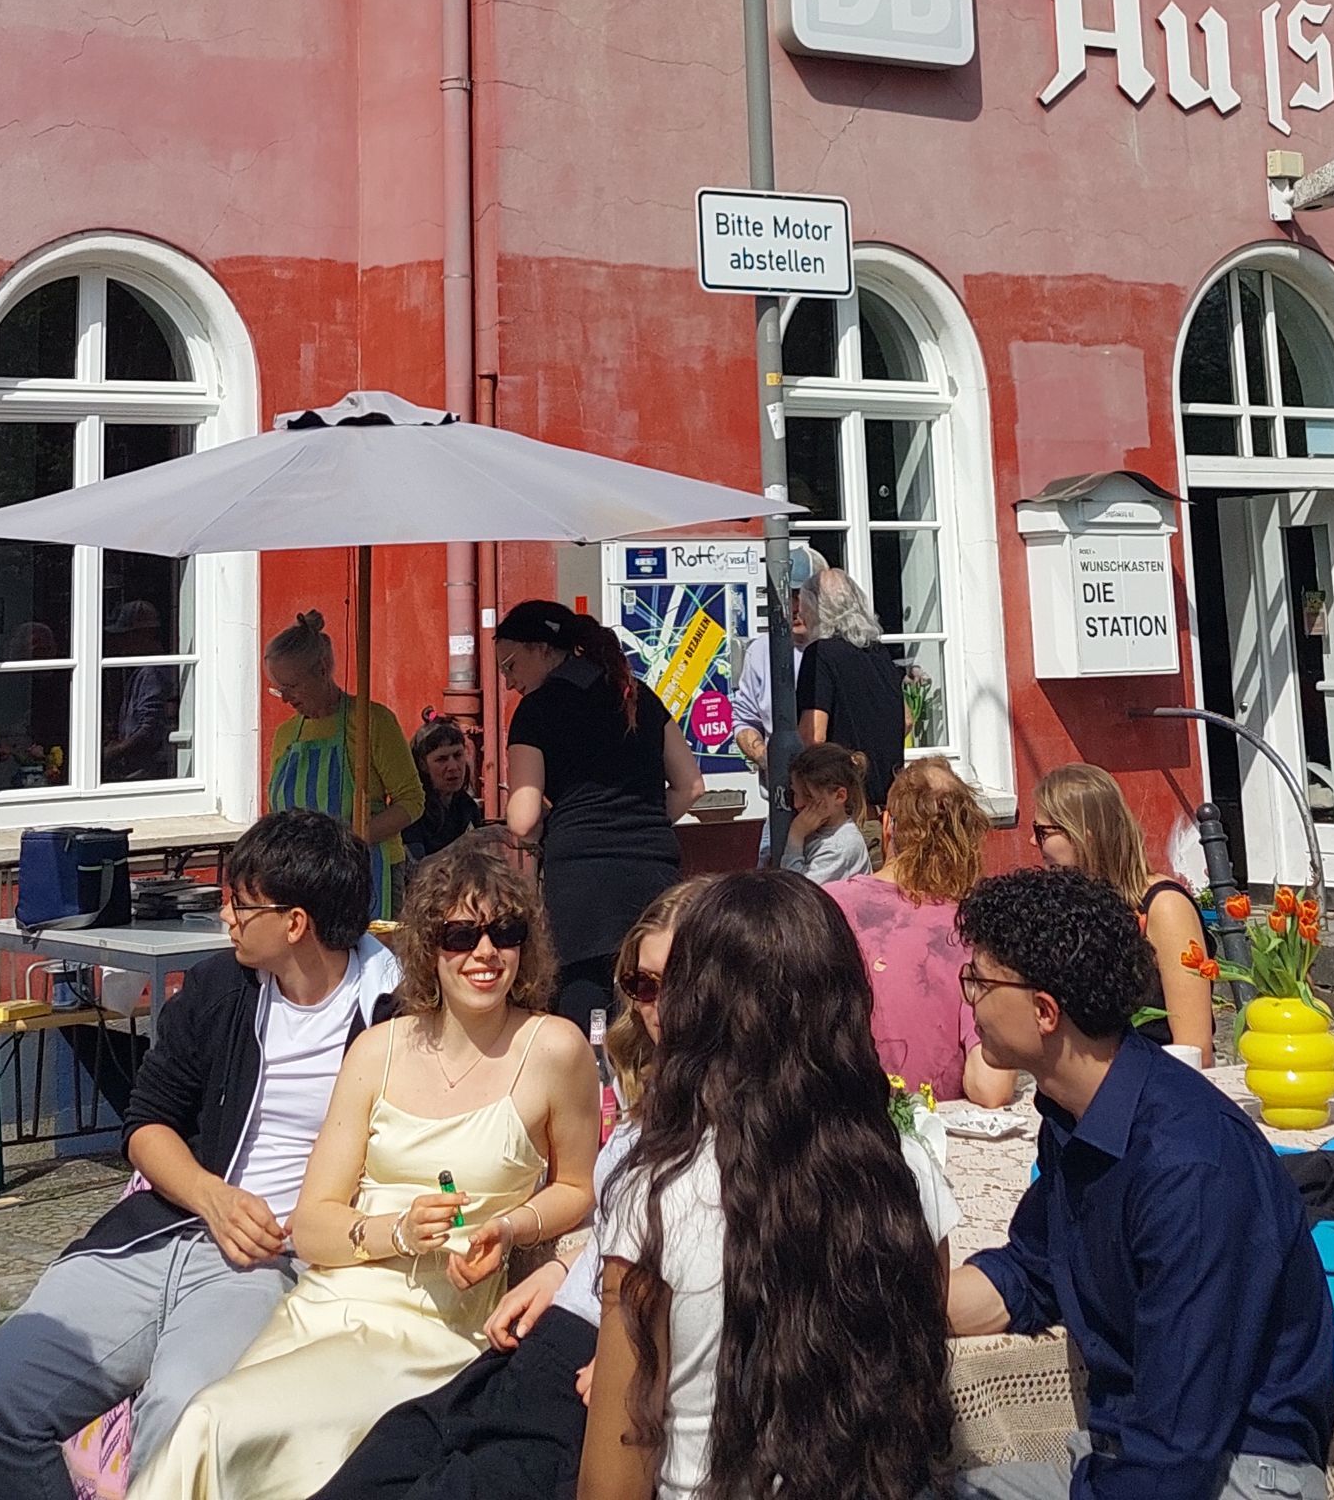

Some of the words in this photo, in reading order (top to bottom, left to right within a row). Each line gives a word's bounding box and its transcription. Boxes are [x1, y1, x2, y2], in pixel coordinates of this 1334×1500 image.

[715, 212, 764, 238] Bitte
[773, 215, 833, 242] Motor
[729, 247, 825, 274] abstellen
[729, 556, 745, 565] VISA
[1079, 560, 1165, 573] WUNSCHKASTEN
[1082, 581, 1116, 603] DIE
[684, 615, 712, 659] BEZAHLEN
[1085, 614, 1168, 638] STATION
[699, 721, 729, 737] VISA
